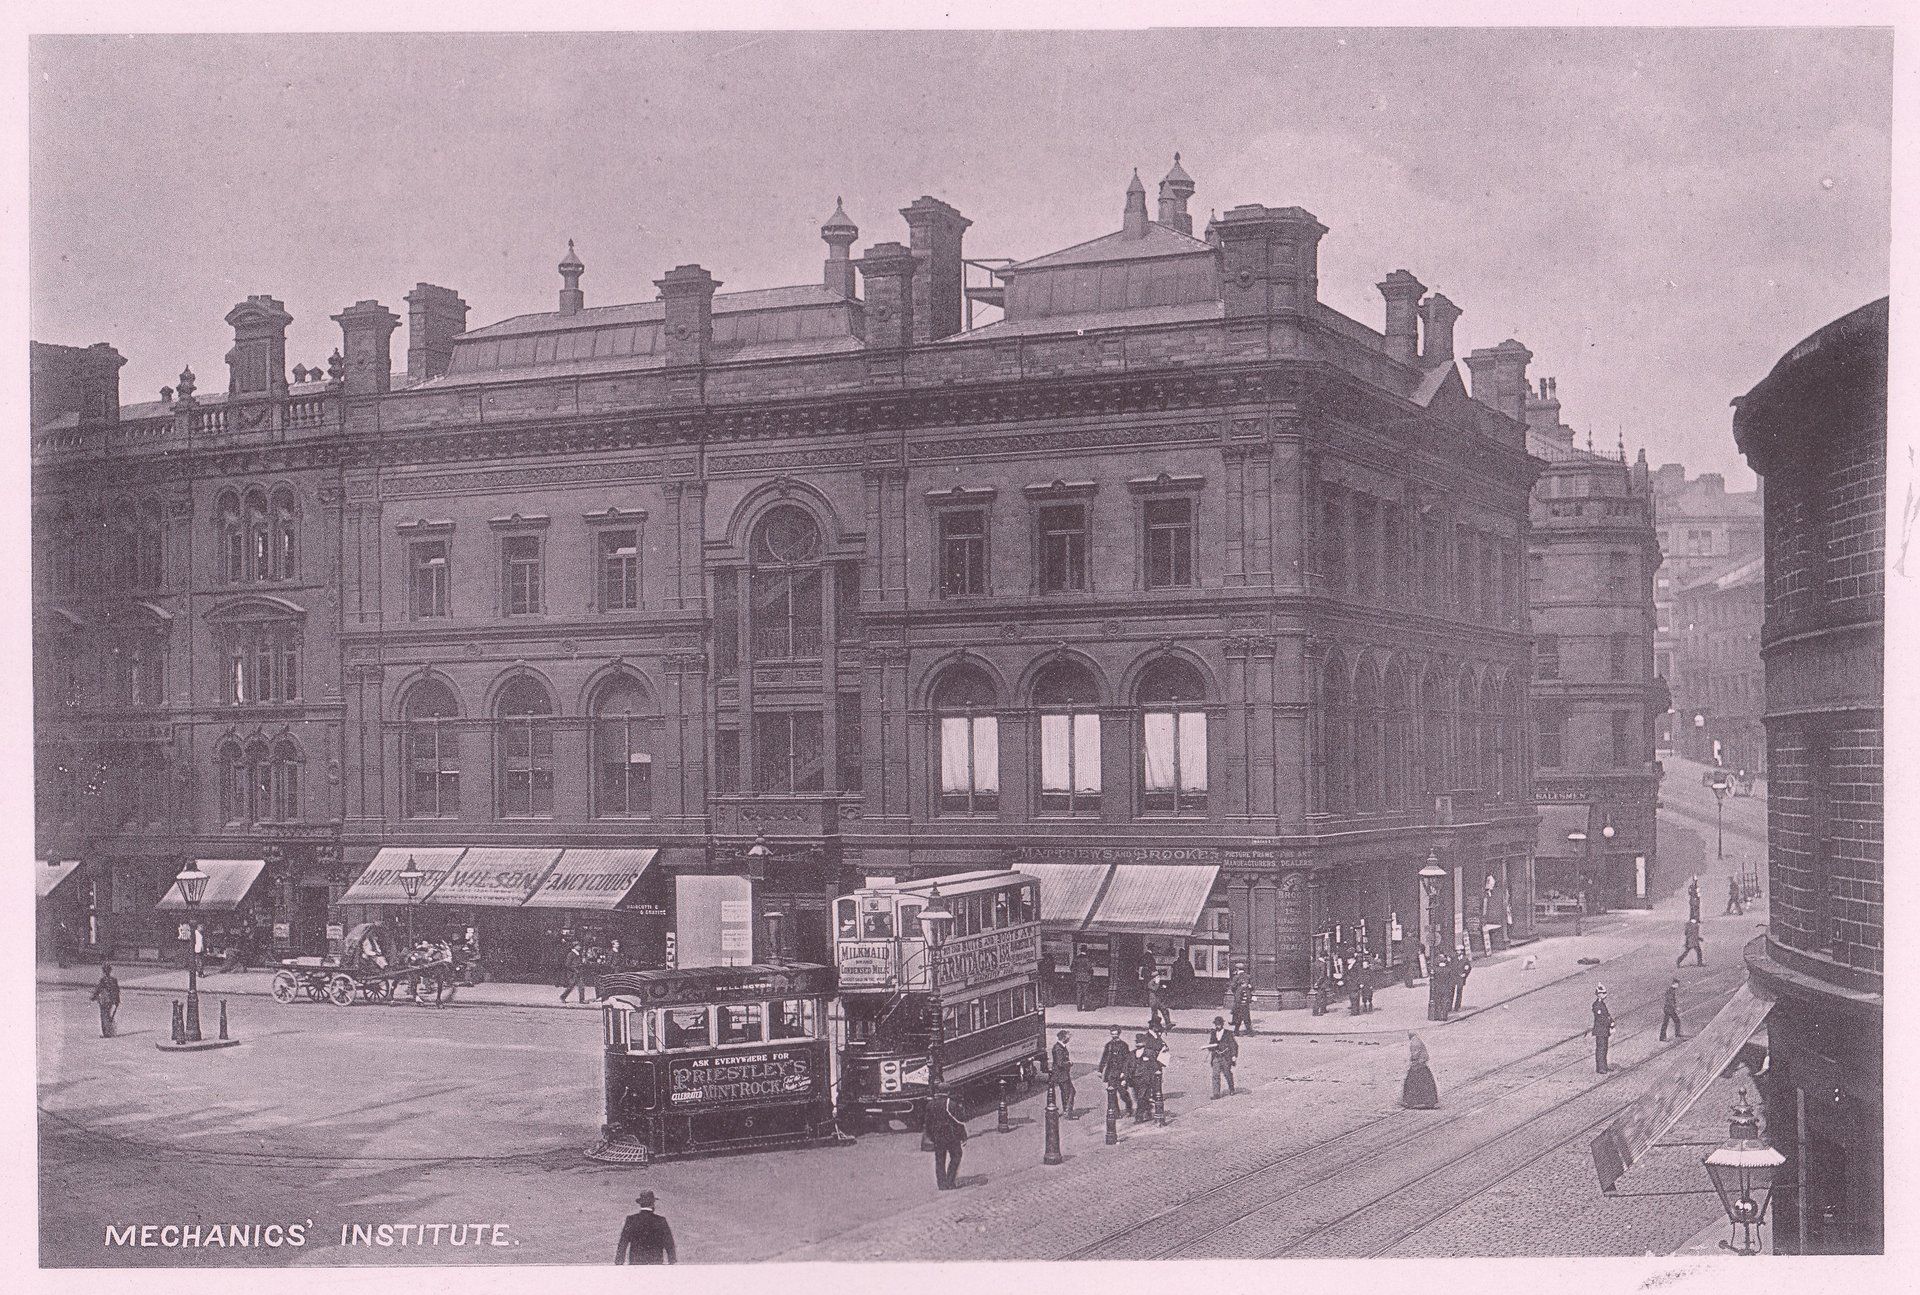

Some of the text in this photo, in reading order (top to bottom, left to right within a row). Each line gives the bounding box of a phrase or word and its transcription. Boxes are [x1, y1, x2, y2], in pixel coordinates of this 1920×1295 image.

[1252, 850, 1274, 858] FRAME
[841, 946, 890, 961] MILKMAID
[692, 1052, 790, 1068] ASK EVERYWHERE FOR
[673, 1059, 807, 1092] PRIESTLEY'S
[671, 1090, 703, 1102] CELEBRATED
